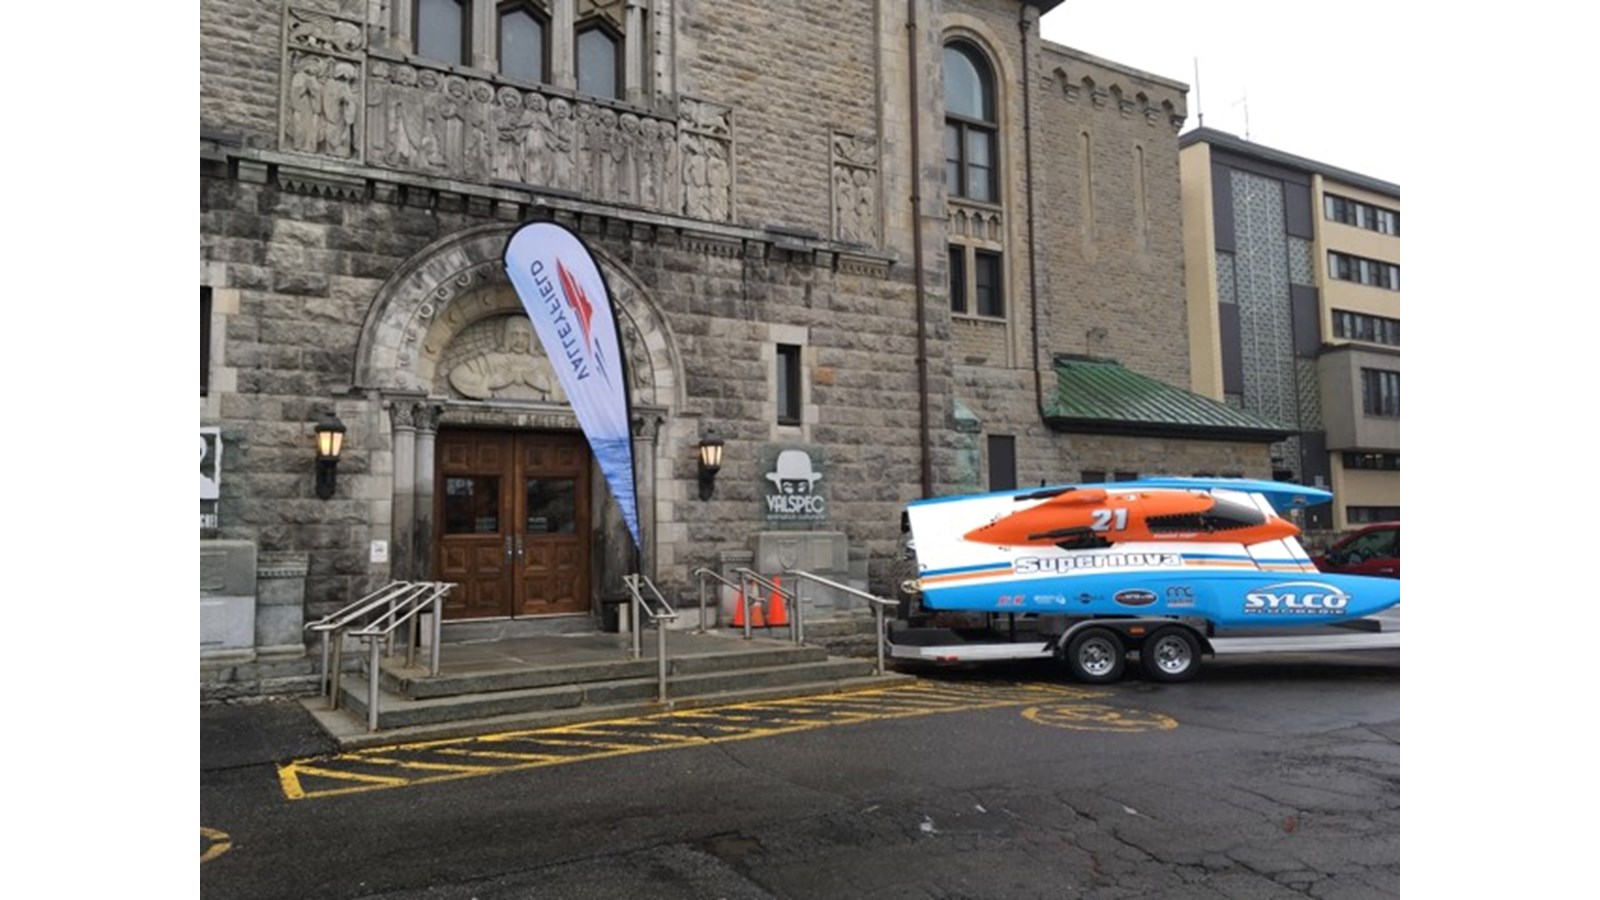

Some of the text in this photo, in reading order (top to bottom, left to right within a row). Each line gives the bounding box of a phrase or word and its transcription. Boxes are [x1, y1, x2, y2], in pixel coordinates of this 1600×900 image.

[765, 494, 825, 514] VALSPEC
[1091, 508, 1129, 531] 21
[1015, 552, 1182, 573] Supernova
[1245, 593, 1352, 609] SYLCO
